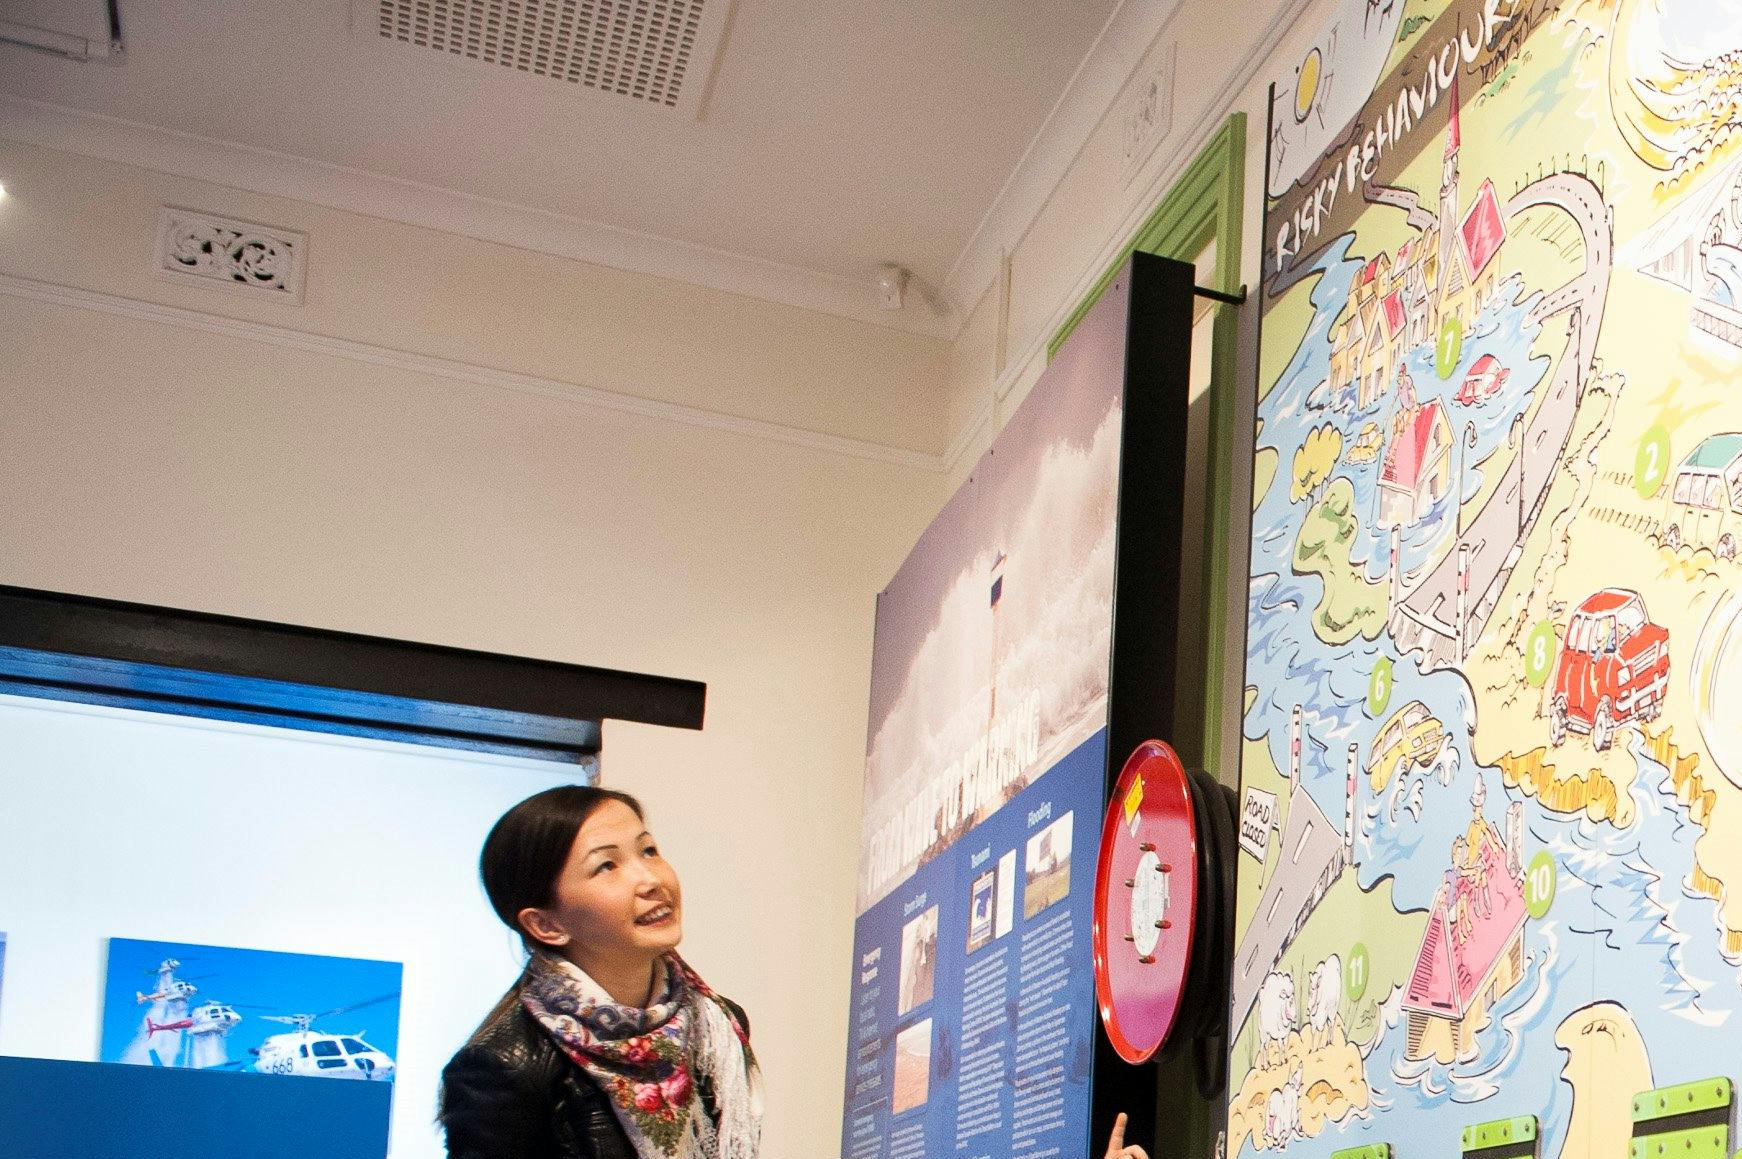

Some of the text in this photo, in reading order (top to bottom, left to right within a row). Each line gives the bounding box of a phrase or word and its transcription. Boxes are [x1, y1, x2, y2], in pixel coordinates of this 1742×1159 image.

[1277, 161, 1342, 271] RISKY
[1643, 443, 1659, 482] 2
[1532, 638, 1545, 668] 8
[1374, 673, 1385, 701] 6
[1245, 795, 1269, 824] ROAD
[1242, 821, 1265, 848] CLOSED
[1529, 866, 1551, 901] 10
[1349, 954, 1363, 988] 11
